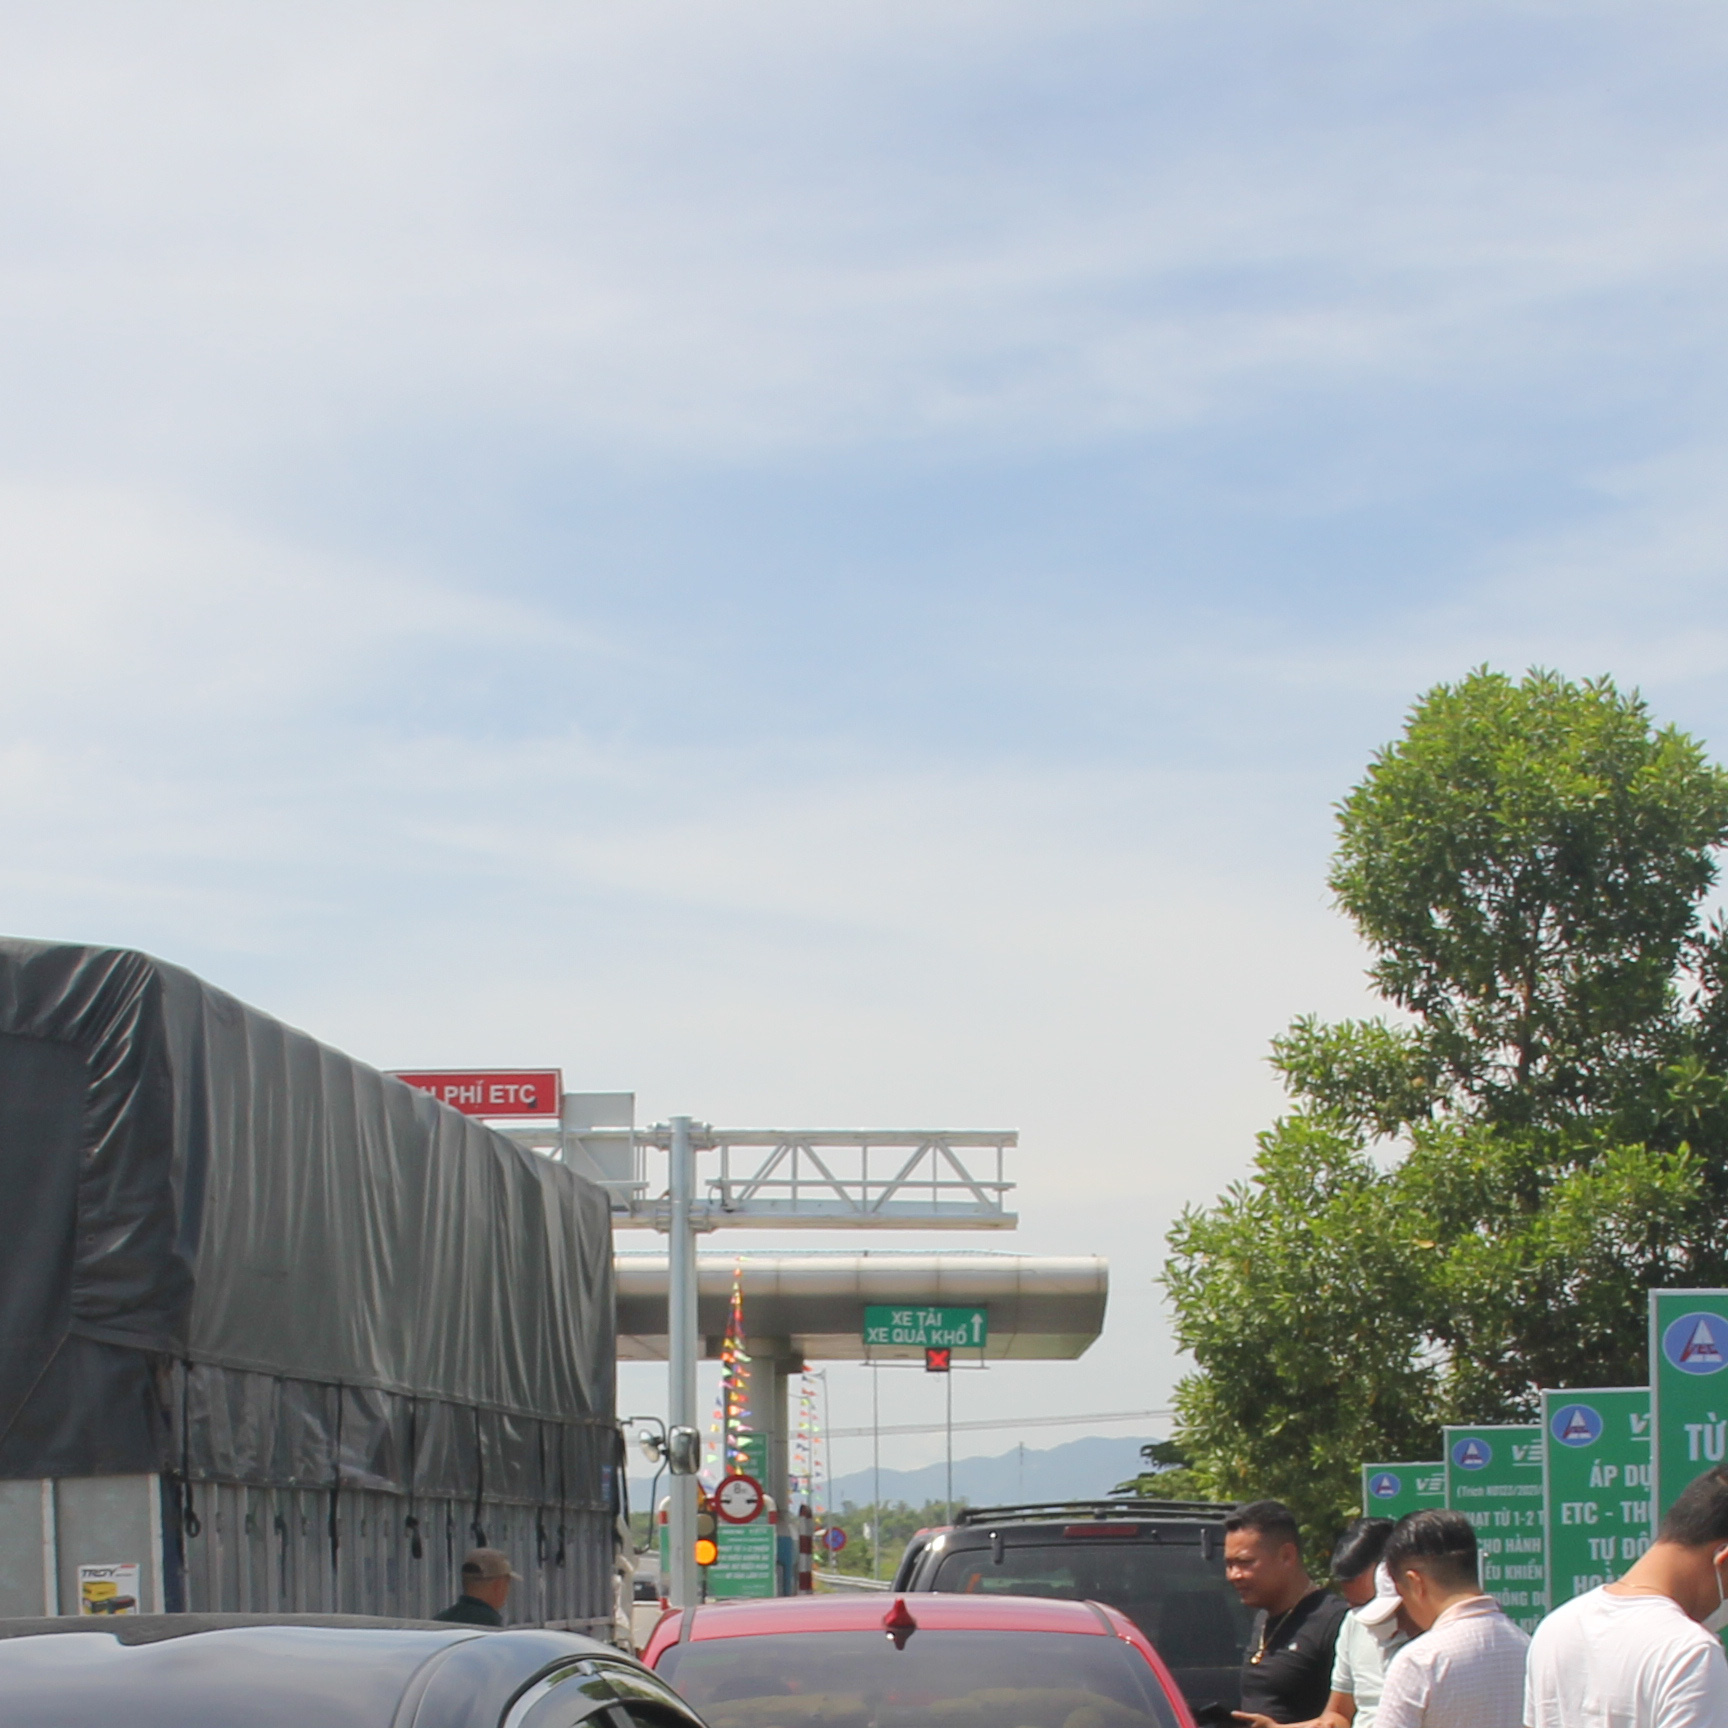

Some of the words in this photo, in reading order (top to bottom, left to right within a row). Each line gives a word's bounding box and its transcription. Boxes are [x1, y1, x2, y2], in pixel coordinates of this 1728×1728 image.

[444, 1079, 483, 1105] PHÍ
[489, 1084, 536, 1104] ETC
[891, 1311, 913, 1326] XE
[867, 1327, 889, 1343] XE
[1684, 1411, 1728, 1461] TỪ
[1589, 1458, 1618, 1489] ÁP
[1562, 1502, 1599, 1525] ETC
[1620, 1500, 1652, 1524] TH
[1588, 1535, 1617, 1565] TỰ
